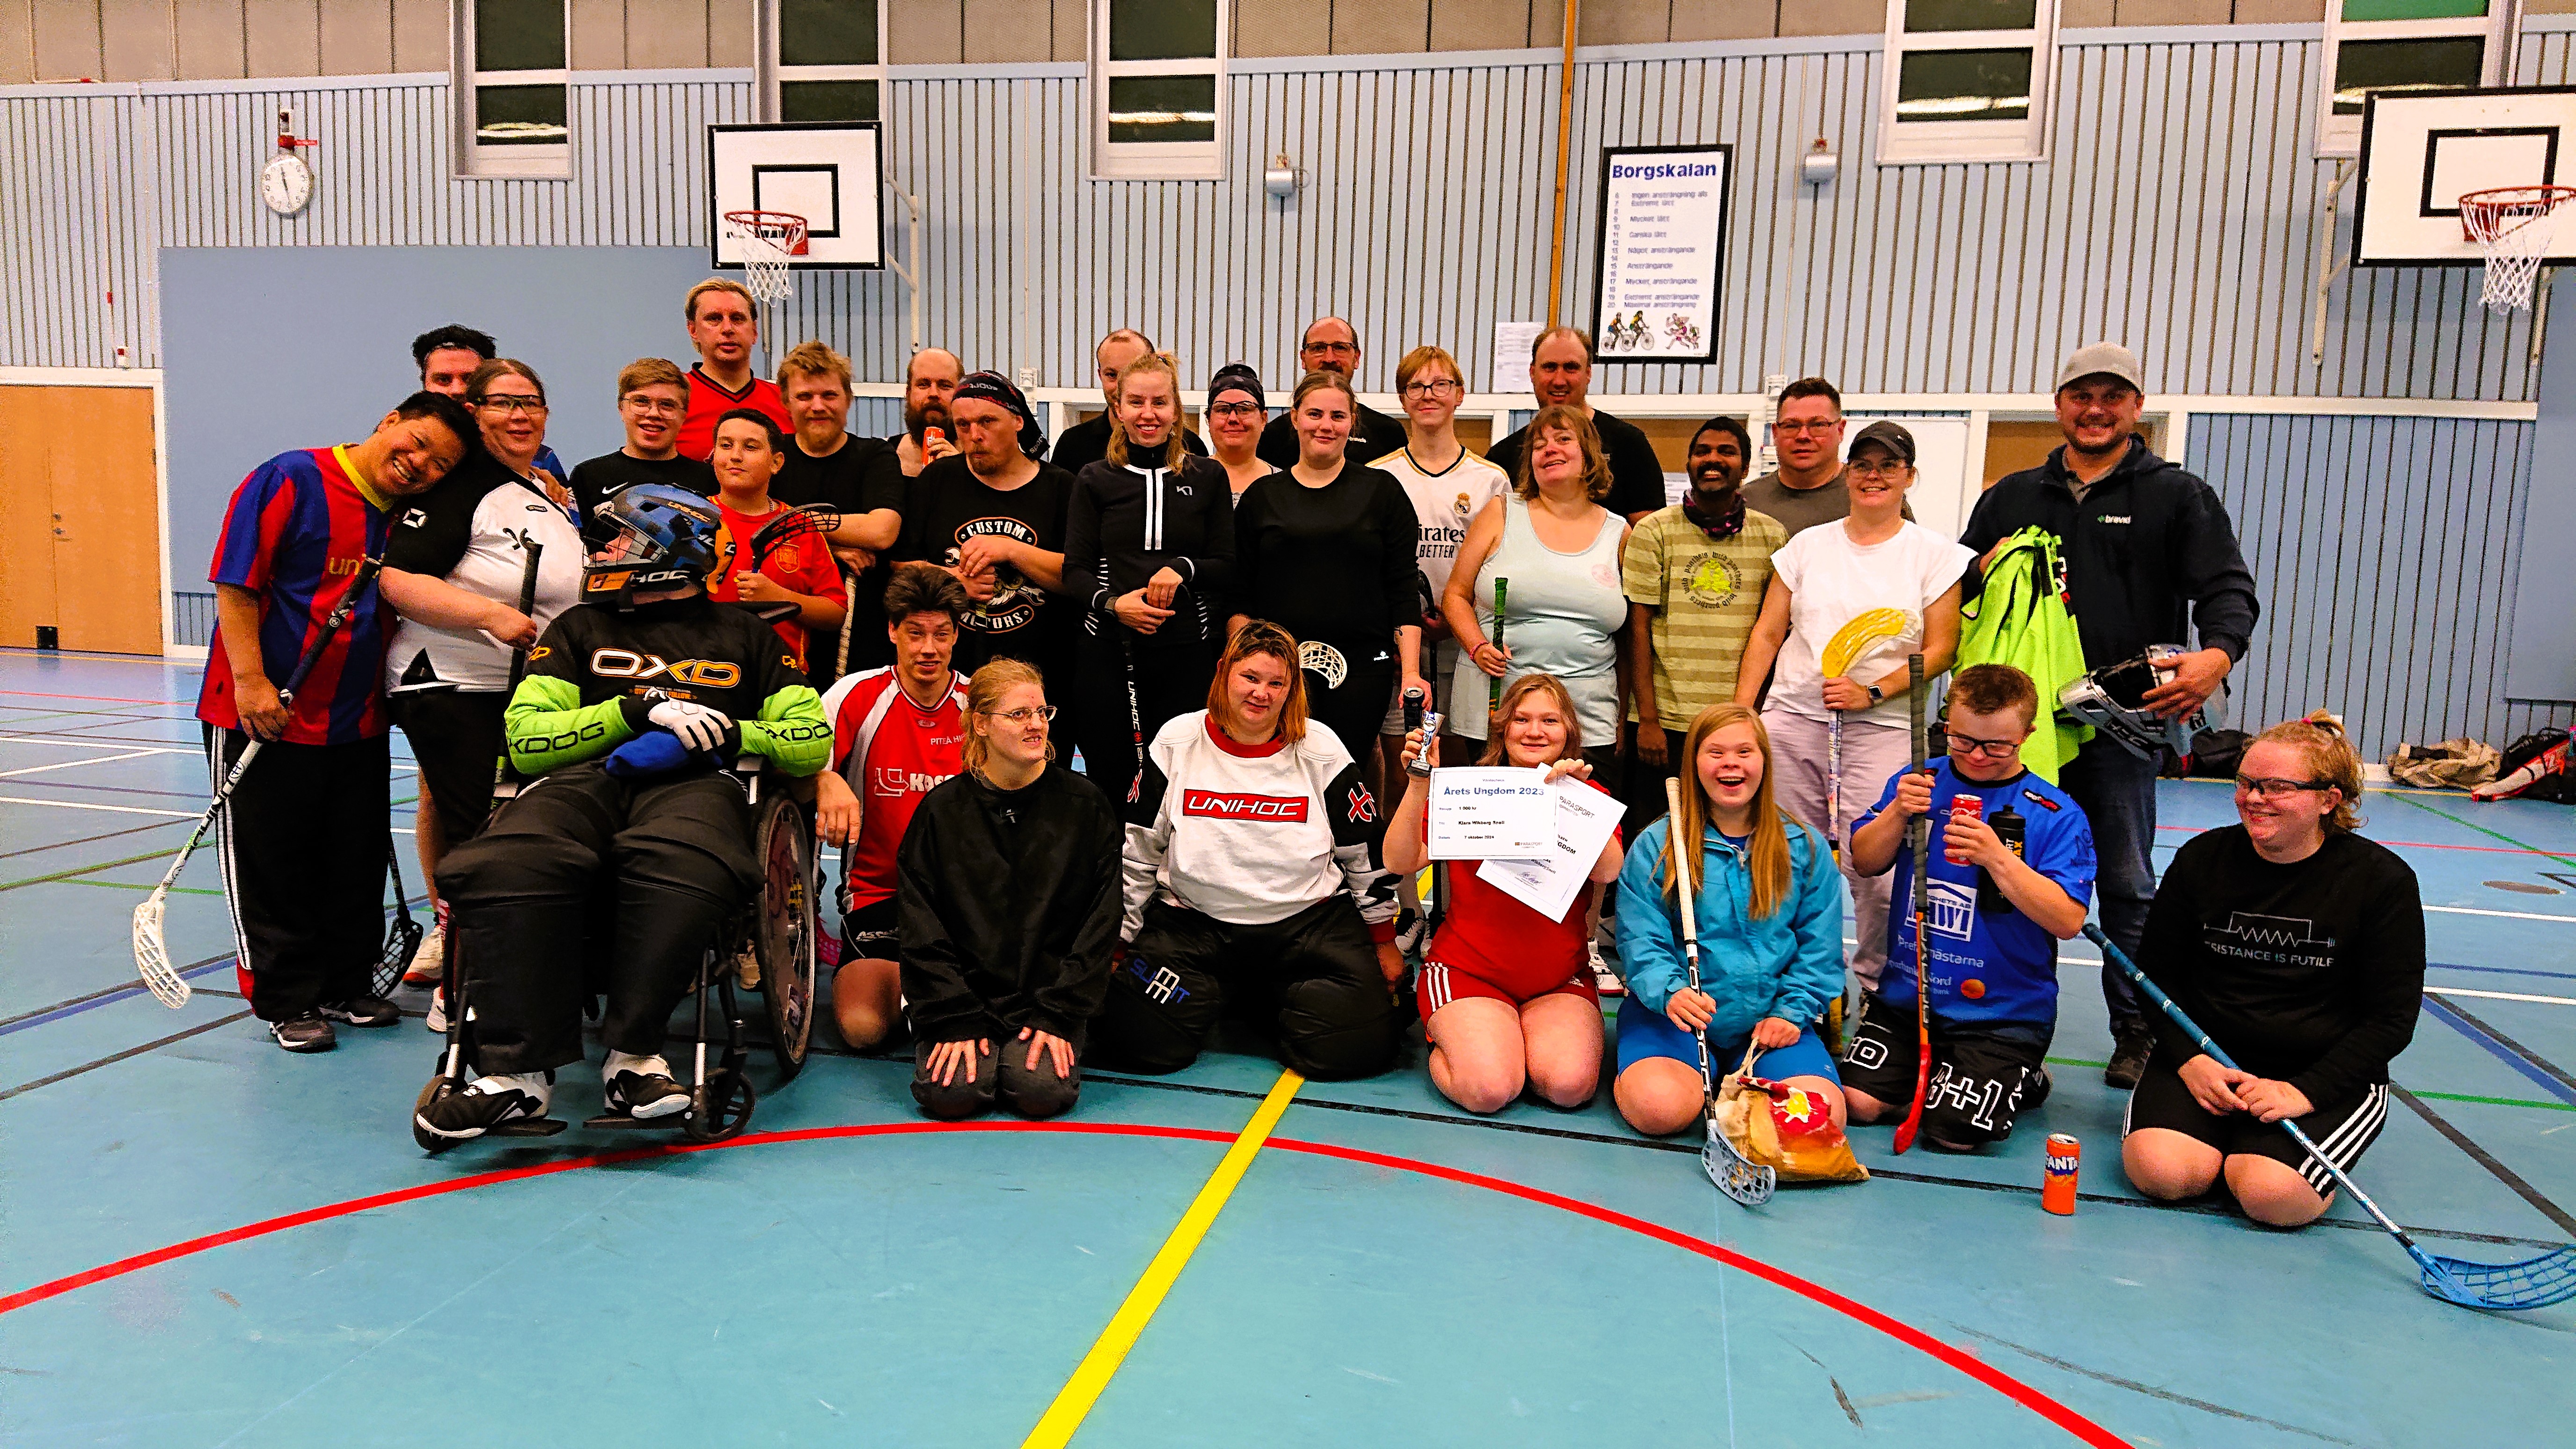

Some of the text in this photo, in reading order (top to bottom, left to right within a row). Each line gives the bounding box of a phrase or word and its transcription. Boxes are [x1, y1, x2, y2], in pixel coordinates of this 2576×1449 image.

[1612, 164, 1716, 180] Borgskalan
[966, 520, 1027, 540] CUSTOM
[1418, 524, 1465, 543] irates
[1419, 544, 1455, 558] BETTER
[1128, 681, 1140, 731] UNIHOC
[930, 736, 952, 746] PITEÅ
[1444, 786, 1471, 795] Årets
[1474, 787, 1515, 796] Ungdom
[1188, 796, 1301, 816] UNIHOC
[1557, 842, 1576, 855] GDOM
[1898, 939, 1984, 968] Prefmästarna
[2204, 941, 2271, 961] SISTANCE
[2275, 952, 2286, 963] IS
